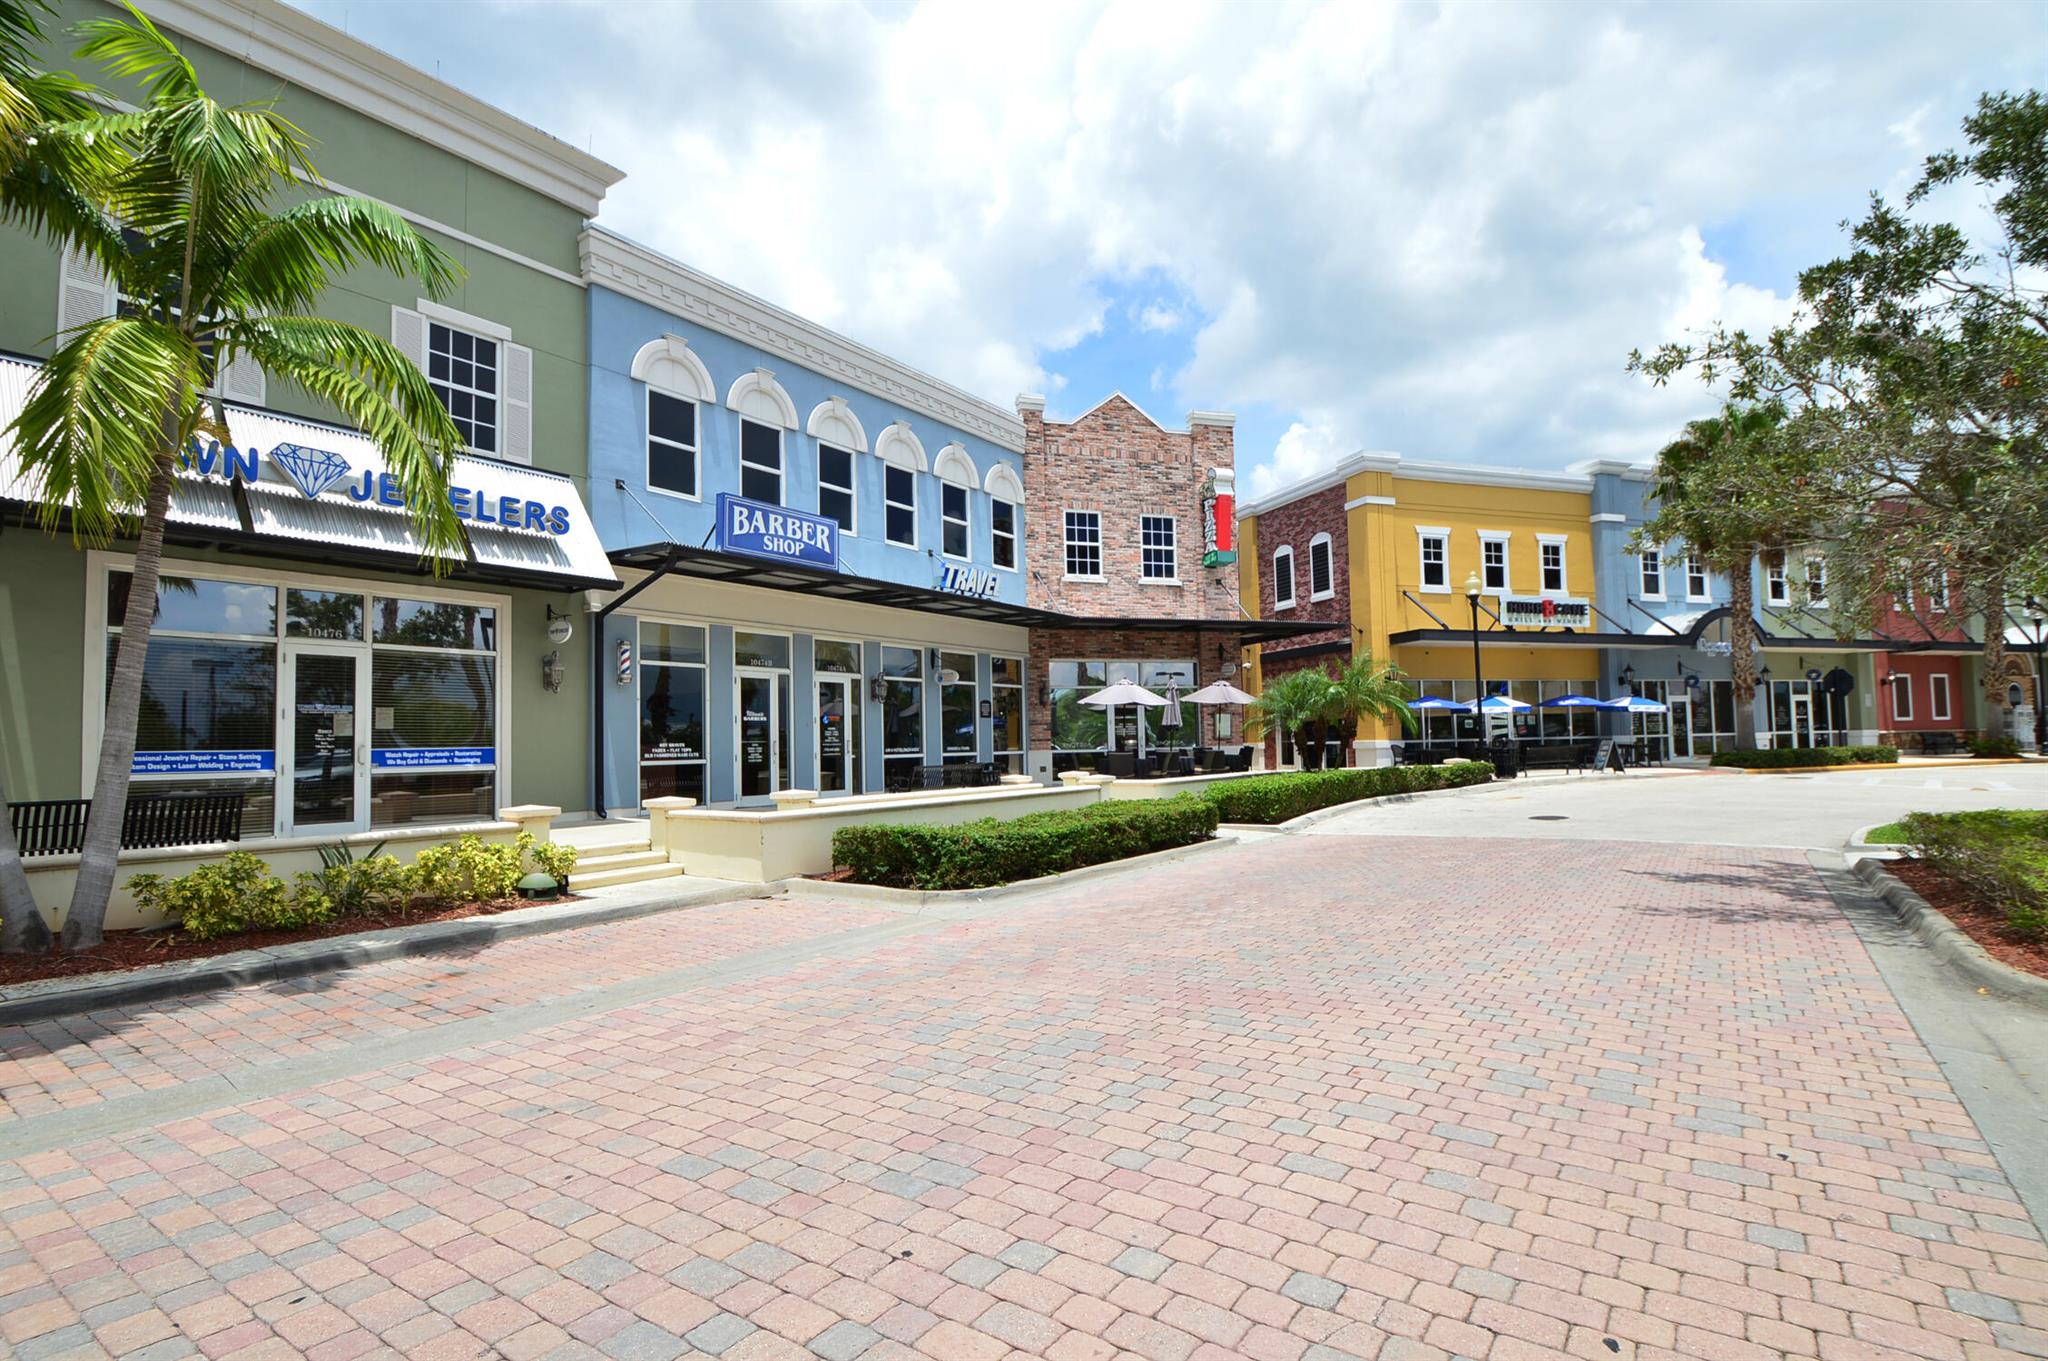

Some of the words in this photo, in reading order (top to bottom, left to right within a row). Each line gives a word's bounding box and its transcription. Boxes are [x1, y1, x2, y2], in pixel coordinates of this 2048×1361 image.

[351, 468, 571, 536] JEELERS
[732, 505, 832, 554] BARBER
[1203, 498, 1218, 554] PIZZA
[762, 535, 805, 555] SHOP
[307, 627, 343, 639] 10476
[147, 762, 171, 771] Design
[162, 754, 189, 762] Jewelry
[190, 753, 212, 762] Repair
[238, 753, 262, 761] Setting
